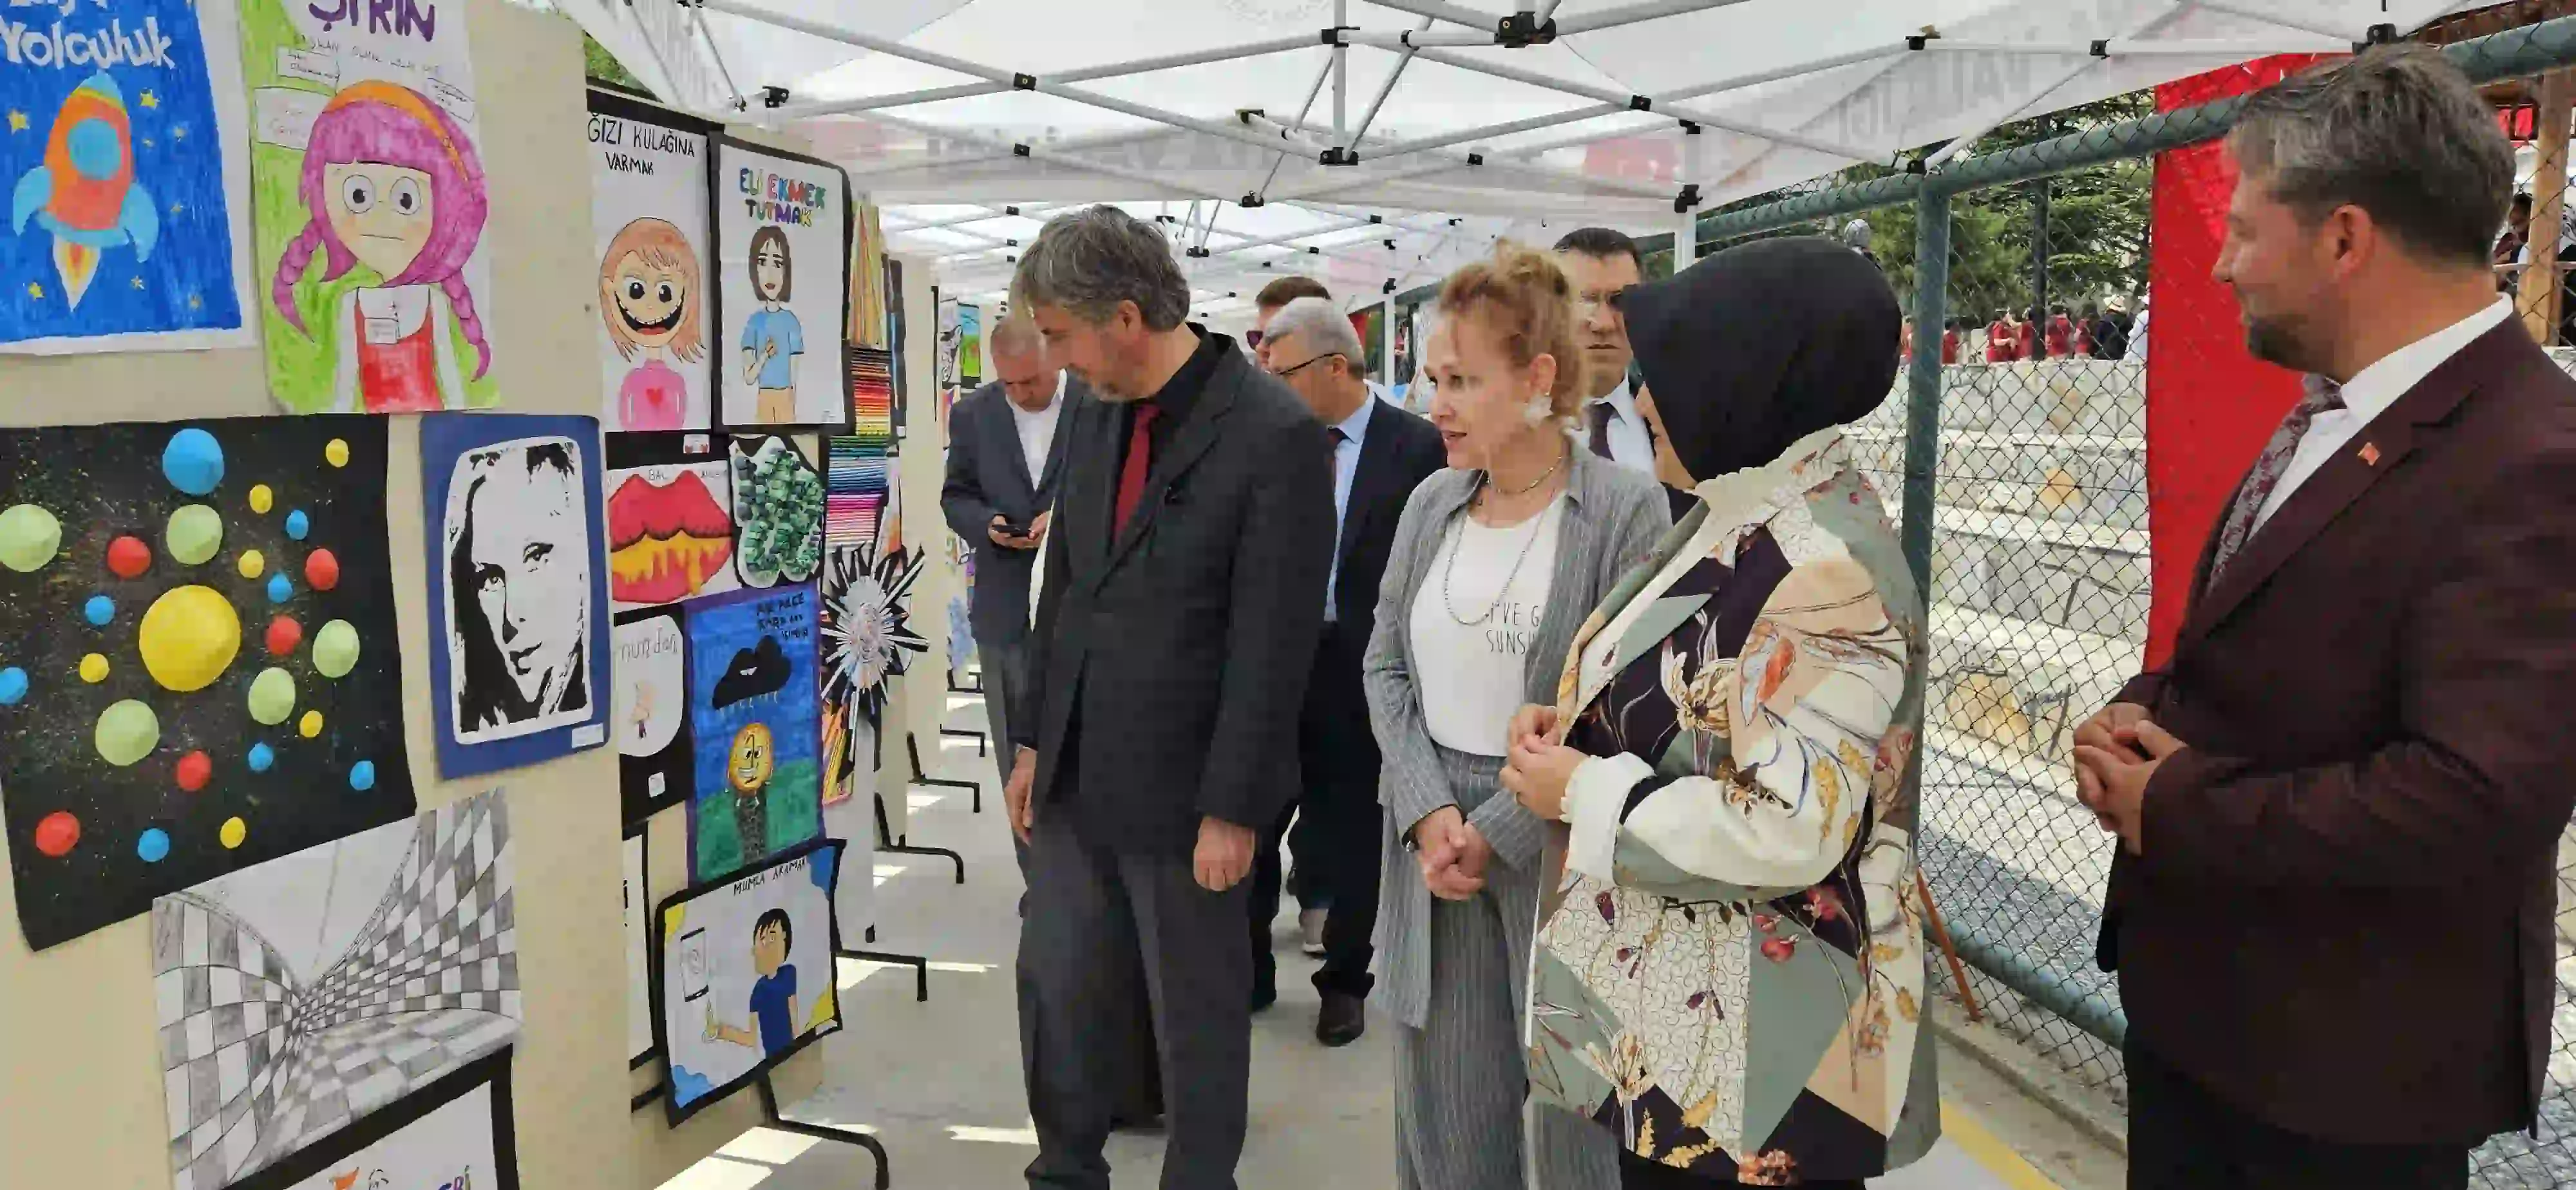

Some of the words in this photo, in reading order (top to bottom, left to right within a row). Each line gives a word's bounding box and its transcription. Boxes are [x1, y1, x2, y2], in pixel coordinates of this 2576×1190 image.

[0, 15, 175, 70] Yolculuk
[634, 126, 694, 157] KULAĞINA
[605, 152, 654, 176] VARMAK
[767, 173, 827, 209] EKMEK
[745, 198, 812, 227] TUTMAK
[734, 873, 765, 896] MUMLA
